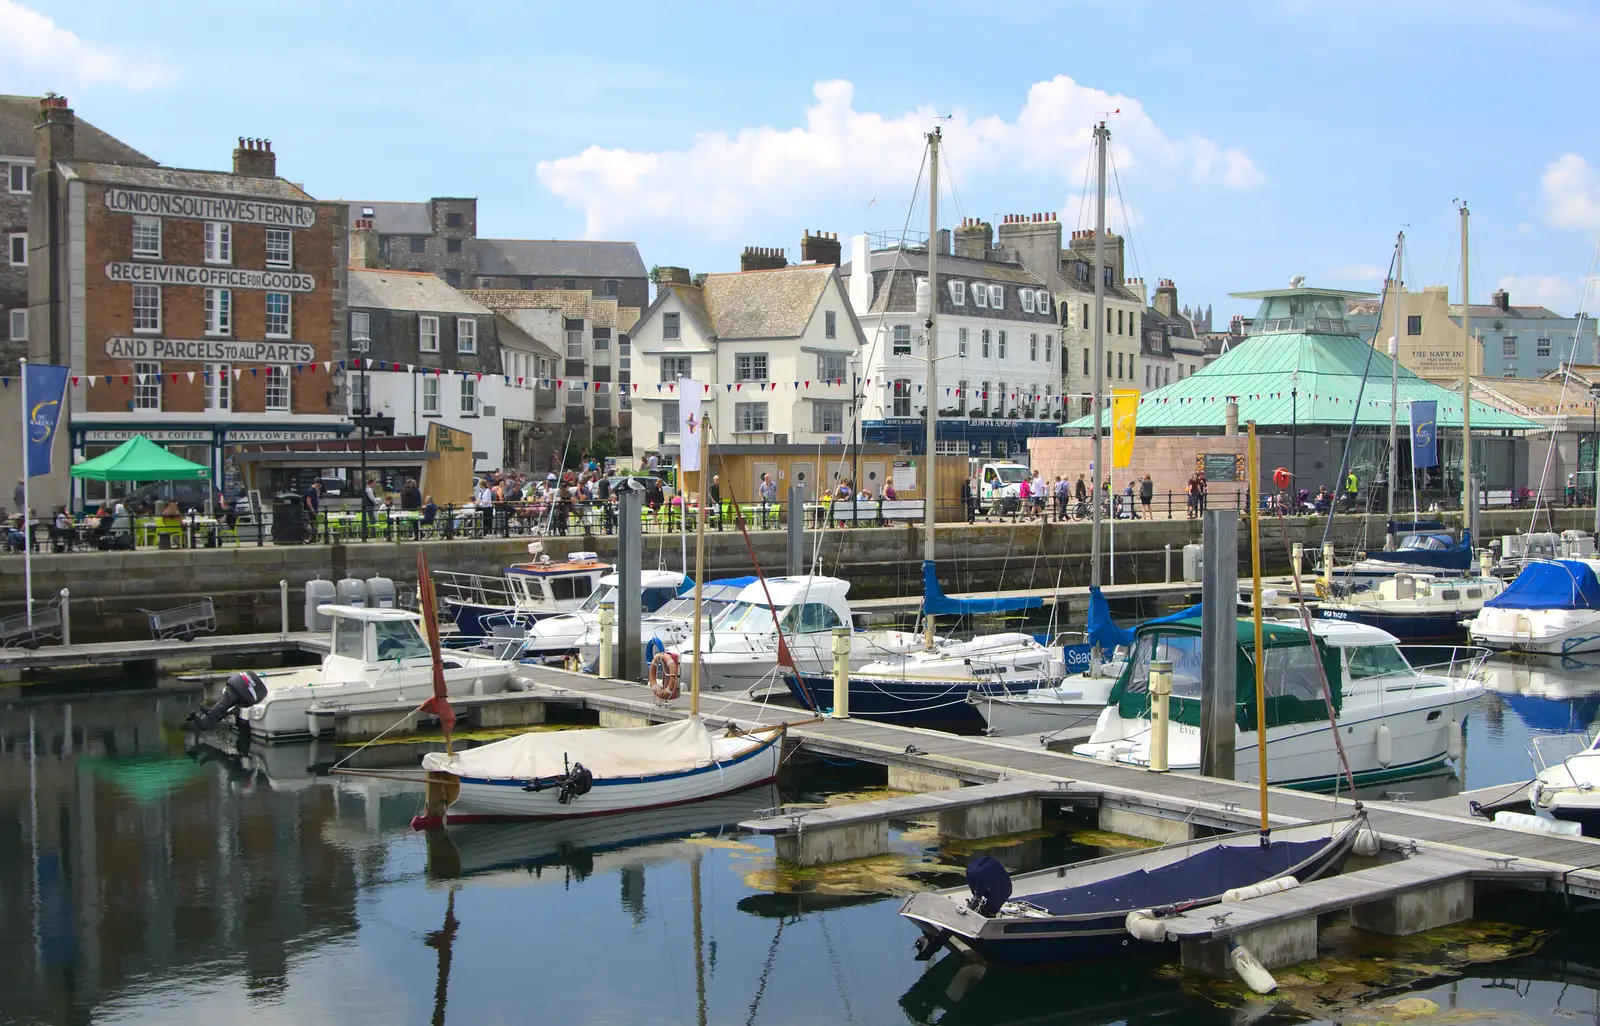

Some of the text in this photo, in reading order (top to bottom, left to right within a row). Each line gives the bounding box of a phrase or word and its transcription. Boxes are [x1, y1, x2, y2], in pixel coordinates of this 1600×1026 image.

[111, 189, 170, 213] LONDON
[171, 196, 222, 217] SOUTH
[221, 200, 294, 224] WESTERN
[111, 263, 312, 290] RECEIVING OFFICE FOR GOODS
[112, 338, 311, 361] AND PARCELS TO ALL PARTS
[968, 418, 989, 426] CROWN
[994, 419, 1018, 427] ANCHOR
[93, 431, 110, 439] ICE
[157, 431, 164, 439] &
[168, 431, 204, 439] COFFEE
[229, 431, 331, 440] MAYFLOWER GIFTS
